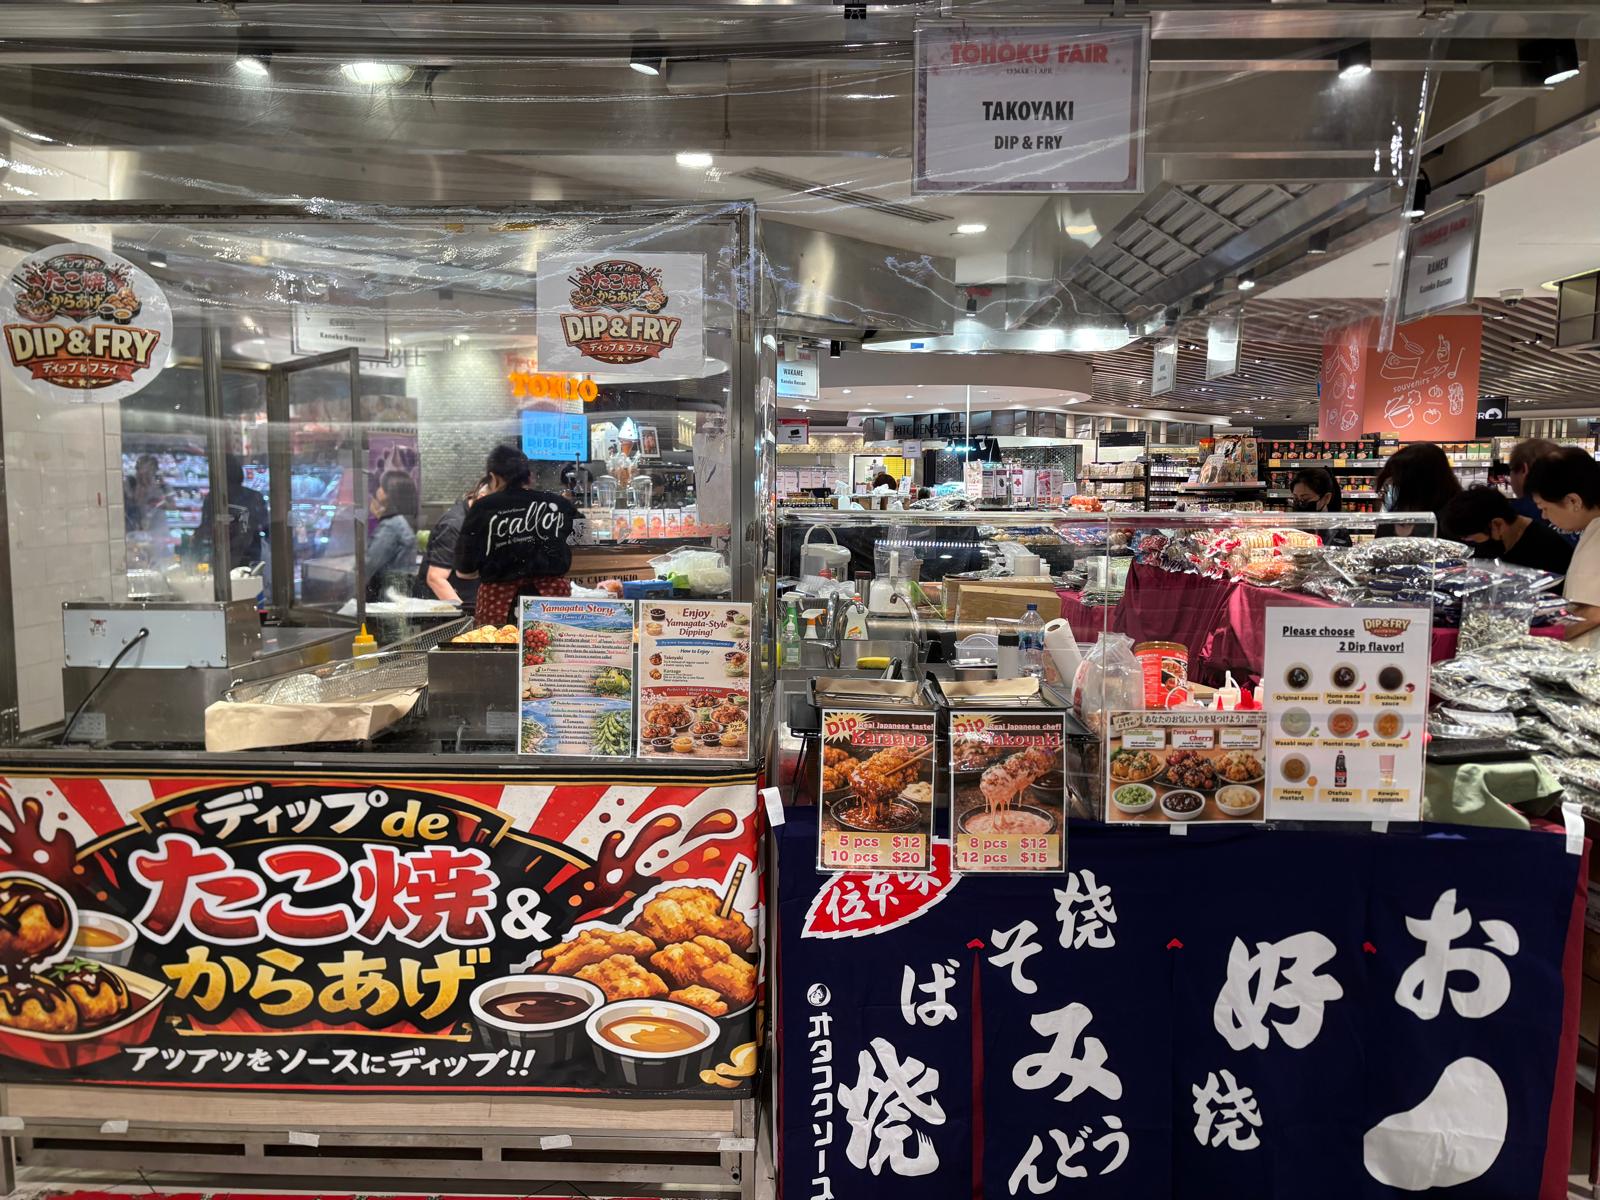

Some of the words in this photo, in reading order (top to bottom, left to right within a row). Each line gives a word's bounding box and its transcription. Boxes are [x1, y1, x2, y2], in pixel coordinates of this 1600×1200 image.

[951, 42, 1049, 65] TOHOKU
[1057, 42, 1108, 65] FAIR
[982, 101, 1074, 121] TAKOYAKI
[994, 136, 1019, 150] DIP
[1021, 136, 1033, 150] &
[1036, 136, 1063, 150] FRY
[49, 294, 104, 309] からあげ
[597, 290, 640, 303] からあげ
[508, 371, 599, 403] TOKIO
[1393, 377, 1431, 393] souvenirs
[540, 603, 585, 615] Yamagata
[682, 608, 711, 620] Enjoy
[666, 619, 728, 630] Yamagata-Style
[1282, 625, 1317, 637] Please
[1319, 626, 1355, 637] choose
[679, 629, 714, 638] Dipping!
[1339, 641, 1346, 651] 2
[1347, 641, 1366, 653] Dip
[1368, 641, 1405, 652] flavor!
[825, 717, 857, 736] Dip
[857, 722, 876, 730] Real
[876, 723, 910, 731] Japanese
[954, 717, 985, 736] Dip
[1006, 723, 1041, 731] Japanese
[851, 730, 928, 747] Karaage
[839, 835, 849, 848] 5
[854, 837, 880, 850] pcs
[891, 836, 921, 849] $12
[970, 838, 979, 849] 8
[983, 840, 1008, 851] pcs
[1020, 837, 1047, 850] $12
[831, 850, 849, 863] 10
[853, 852, 879, 865] pcs
[891, 851, 921, 864] $20
[961, 852, 979, 864] 12
[983, 854, 1008, 866] pcs
[1020, 852, 1047, 865] $15
[162, 946, 491, 1017] からあげ
